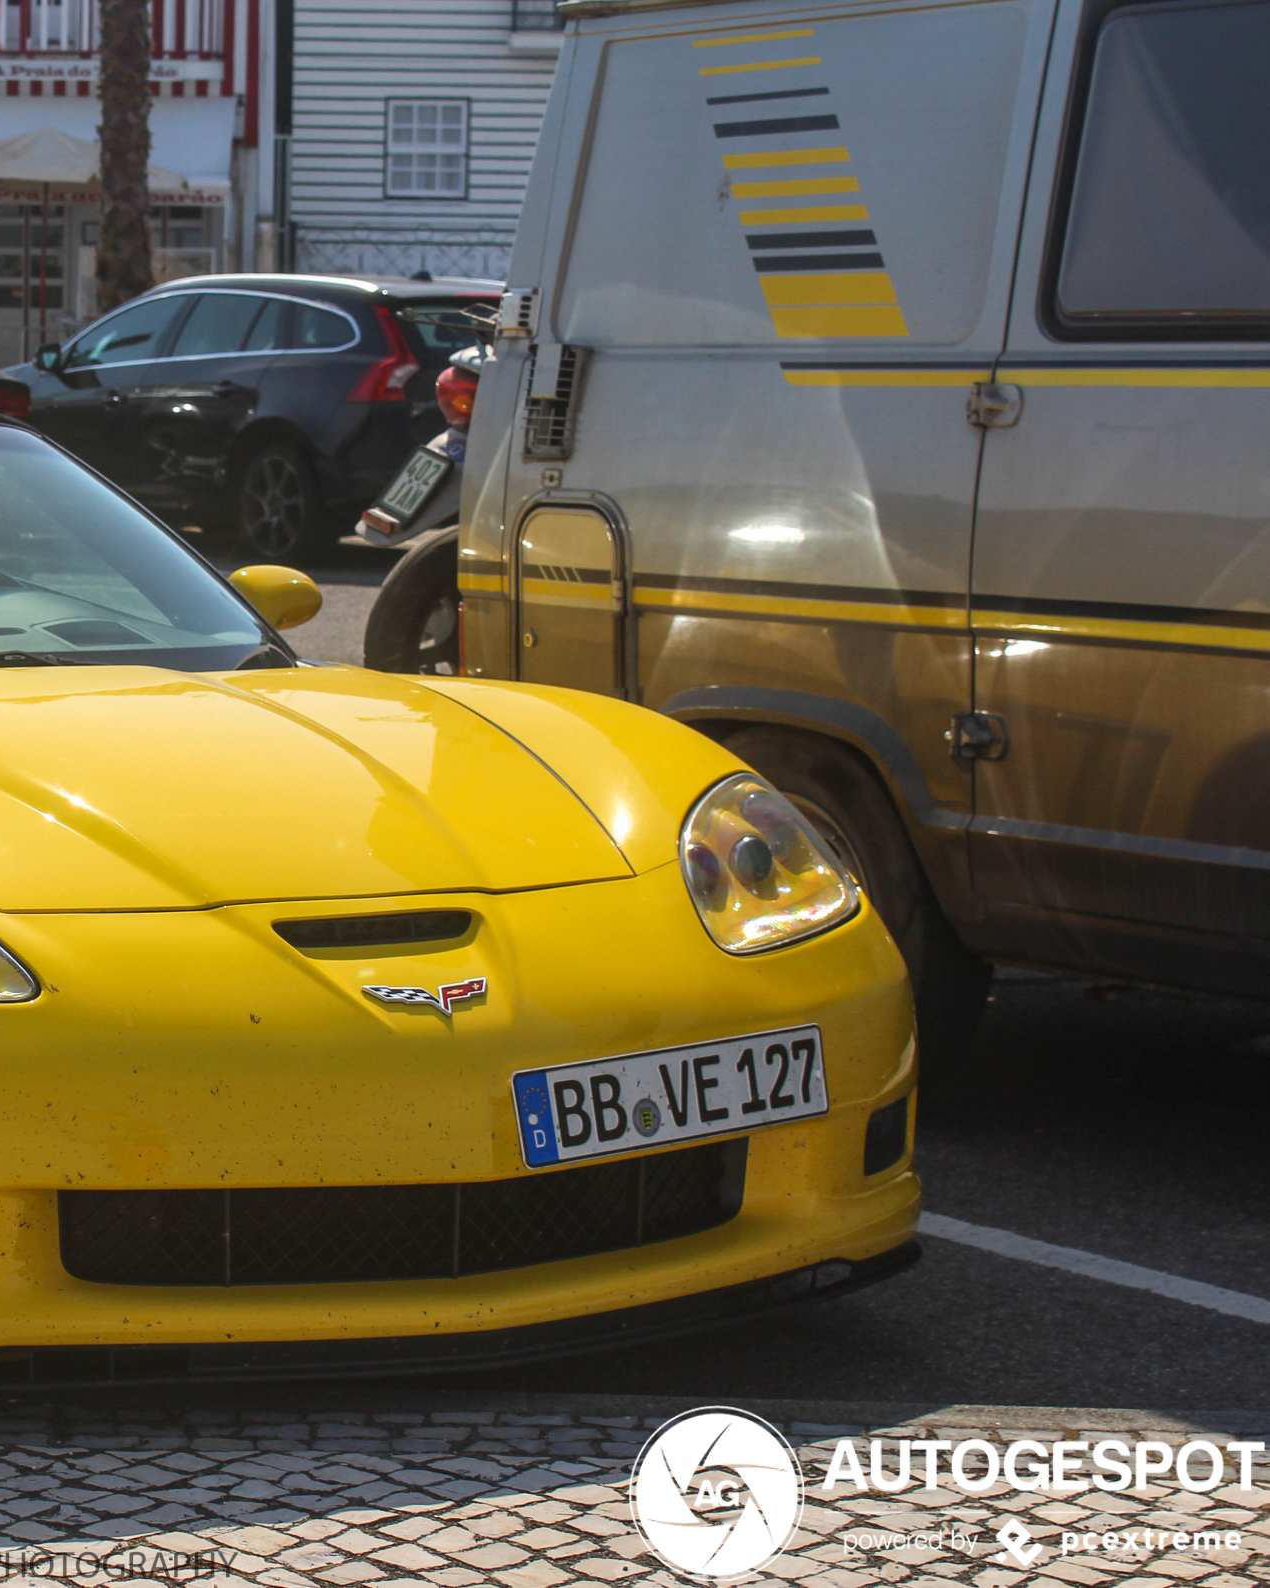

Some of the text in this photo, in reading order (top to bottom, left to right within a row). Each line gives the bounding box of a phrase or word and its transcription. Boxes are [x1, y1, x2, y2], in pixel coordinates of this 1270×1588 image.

[11, 64, 66, 78] Praia
[68, 64, 92, 78] do
[406, 454, 442, 487] 402
[387, 481, 425, 512] JAN
[552, 1038, 816, 1149] BB VE 127
[533, 1129, 547, 1149] D
